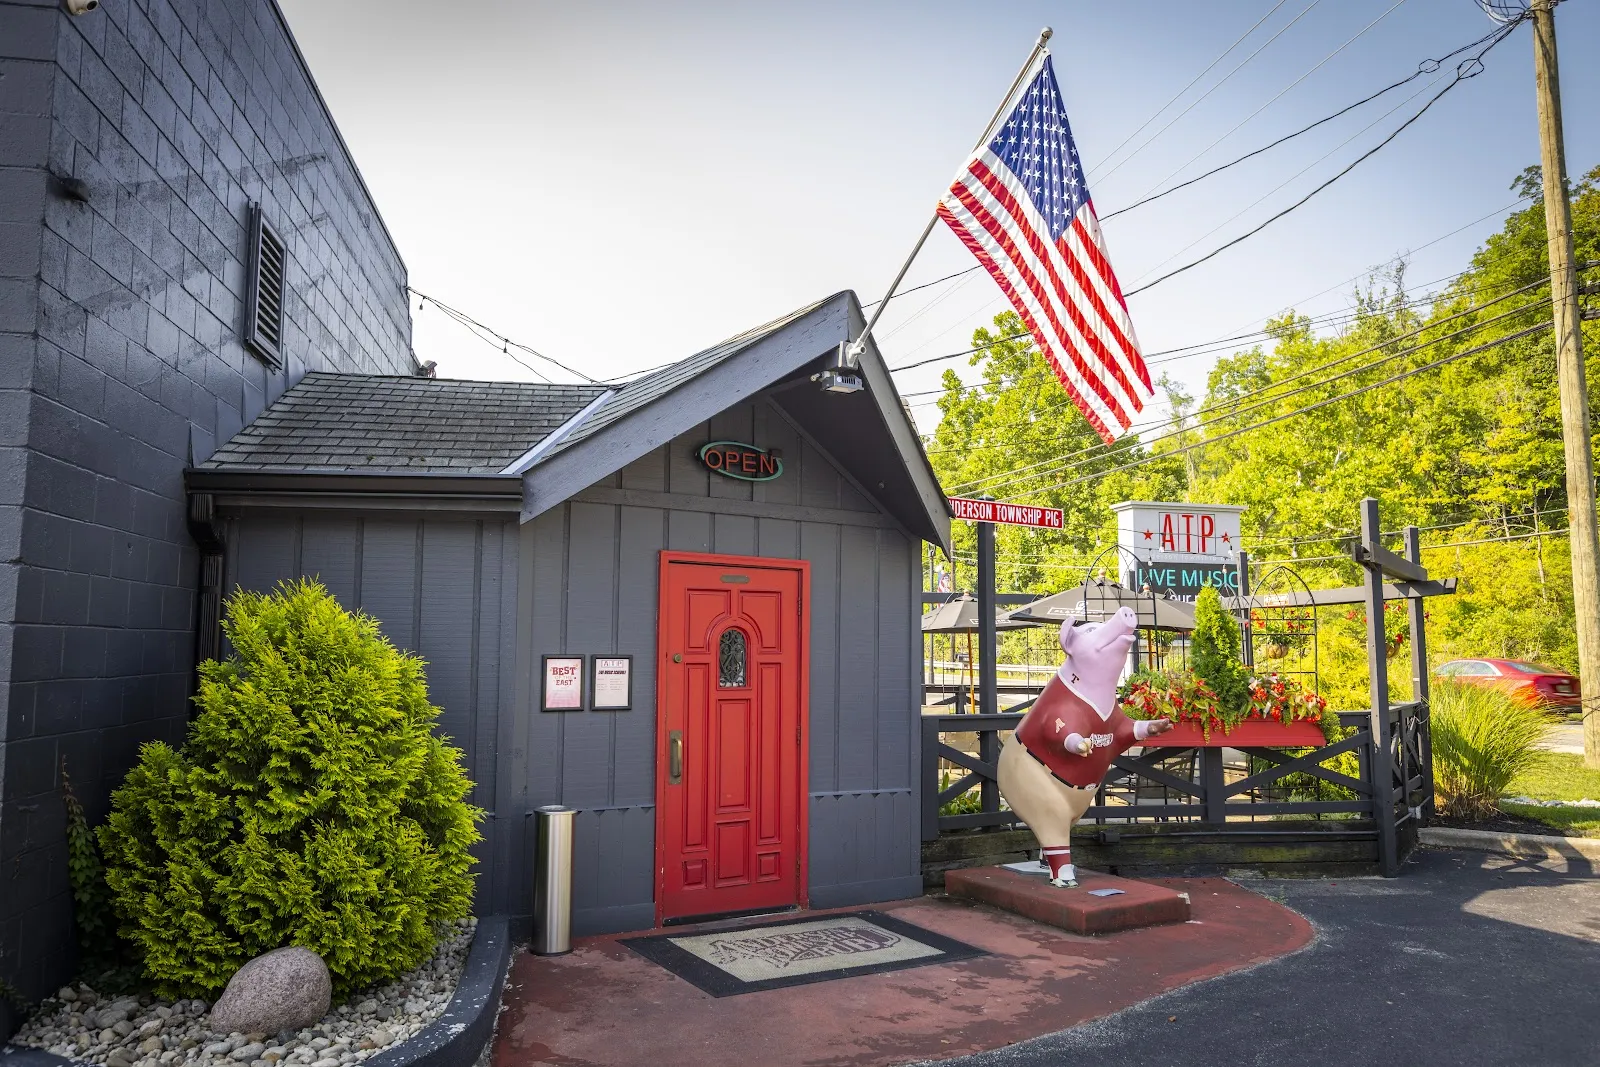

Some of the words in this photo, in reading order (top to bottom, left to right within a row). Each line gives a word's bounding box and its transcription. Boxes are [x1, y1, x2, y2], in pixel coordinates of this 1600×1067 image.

[705, 450, 774, 473] OPEN
[948, 500, 992, 520] NDERSON
[995, 505, 1042, 525] TOWNSHIP
[1045, 510, 1059, 527] PIG
[1163, 513, 1214, 552] ATP
[1138, 568, 1176, 587] LIVE
[1182, 569, 1239, 589] MUSIC
[551, 666, 577, 676] BEST
[1070, 673, 1080, 684] T
